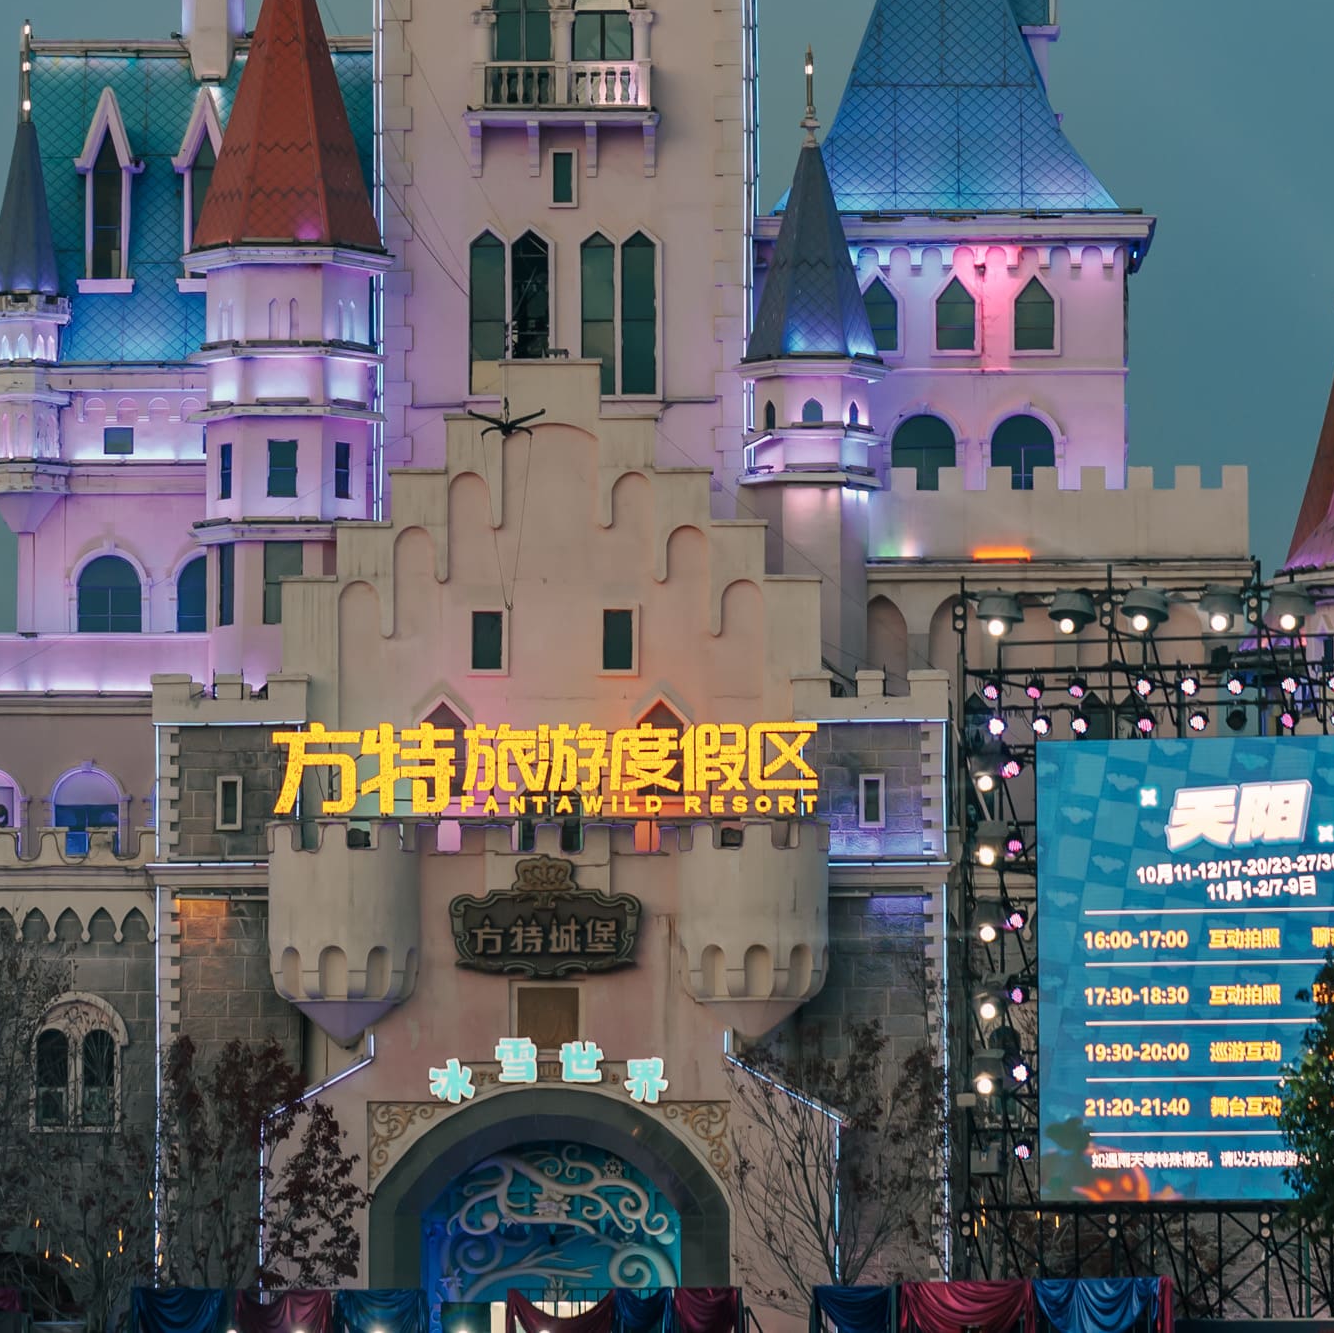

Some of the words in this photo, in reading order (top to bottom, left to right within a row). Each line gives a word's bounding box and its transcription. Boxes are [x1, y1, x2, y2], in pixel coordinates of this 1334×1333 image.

[271, 722, 819, 814] 方特旅游度假区
[460, 795, 663, 814] FANTAWILD
[684, 795, 819, 814] RESORT
[1164, 779, 1312, 853] 天阳
[1206, 875, 1316, 901] 11月1-2/7-9日
[470, 914, 617, 954] 方特城堡
[1084, 930, 1189, 949] 16:00-17:00
[1208, 928, 1281, 949] 互动拍照
[1084, 986, 1189, 1005] 17:30-18:30
[1208, 984, 1281, 1005] 互动拍照
[1085, 1043, 1190, 1062] 19:30-20:00
[1210, 1041, 1281, 1062] 巡游互动
[429, 1037, 669, 1104] 冰雪世界
[1084, 1098, 1190, 1117] 21:20-21:40
[1210, 1096, 1282, 1117] 舞台互动
[1091, 1150, 1319, 1169] 如遇雨天等特殊情况，请以方特旅游
